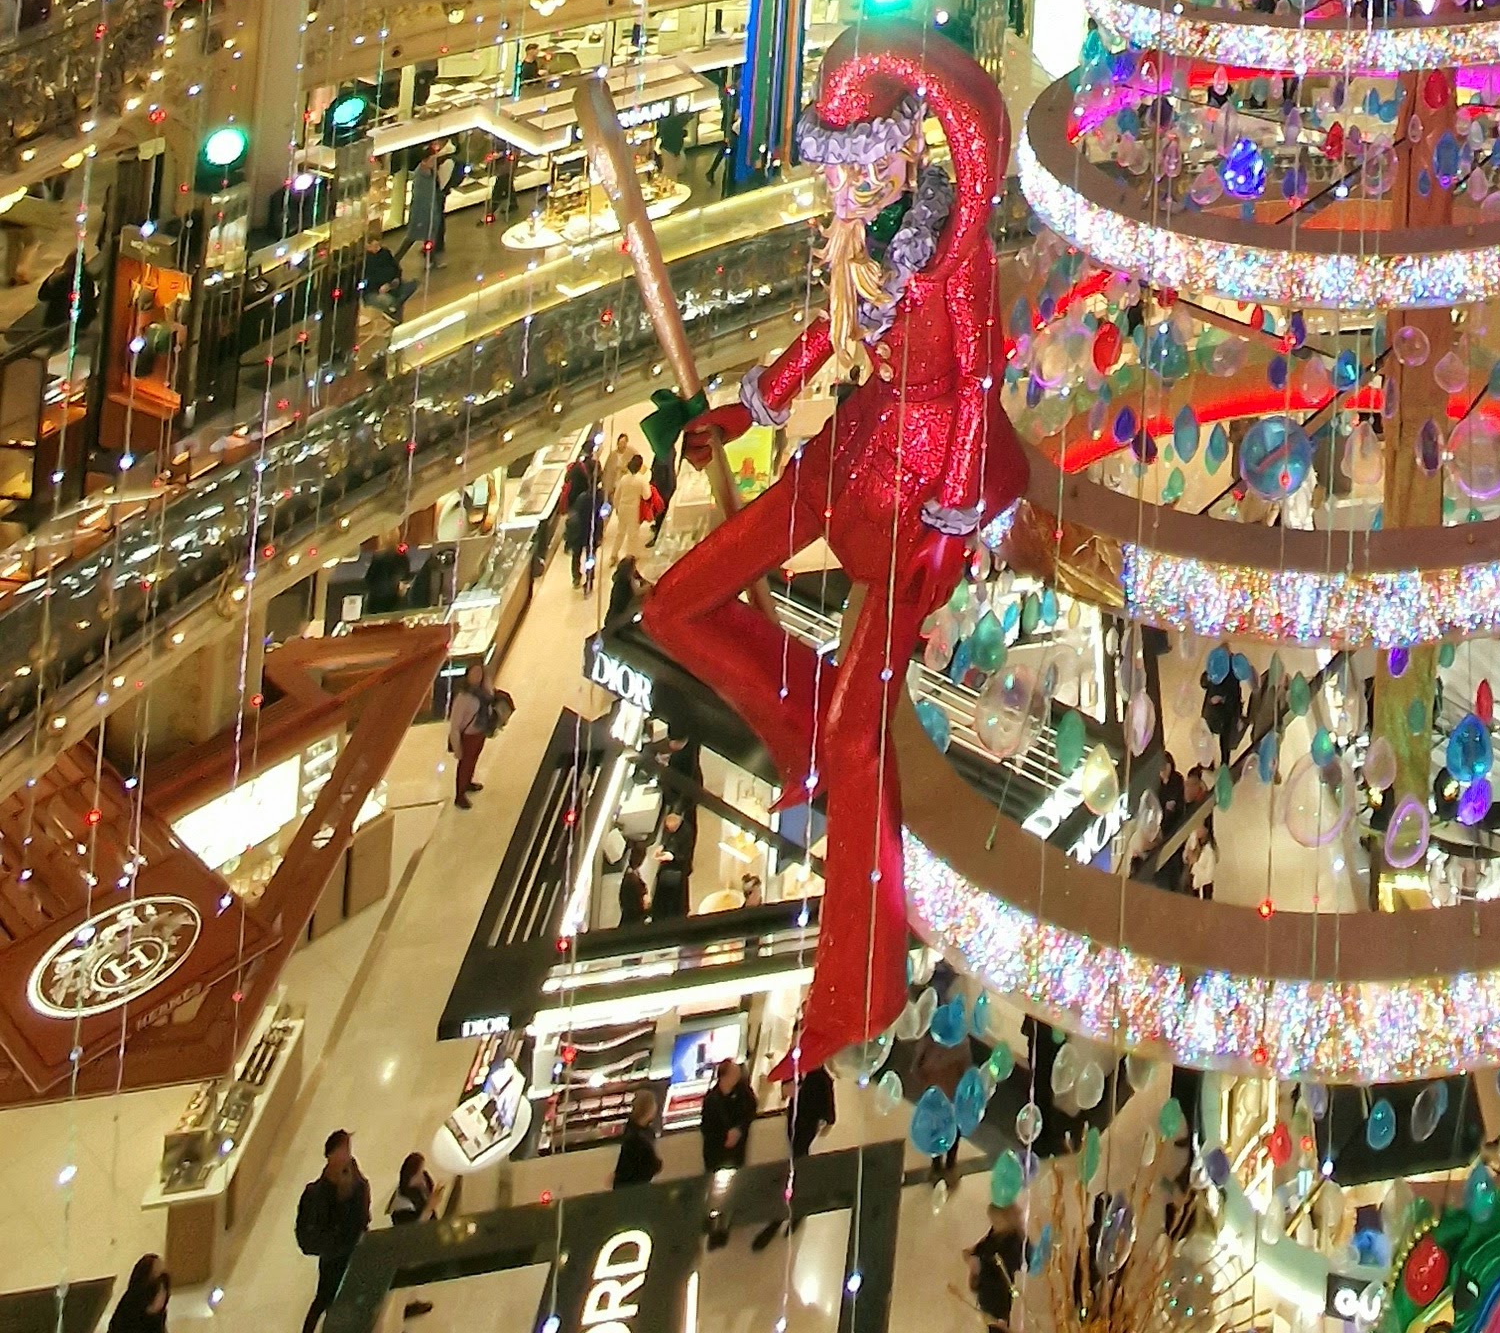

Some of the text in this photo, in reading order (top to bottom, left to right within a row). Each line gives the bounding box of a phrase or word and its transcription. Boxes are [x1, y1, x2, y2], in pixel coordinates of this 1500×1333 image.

[592, 651, 653, 712] DIOR
[462, 1016, 510, 1038] DIOR
[581, 1229, 652, 1333] RD
